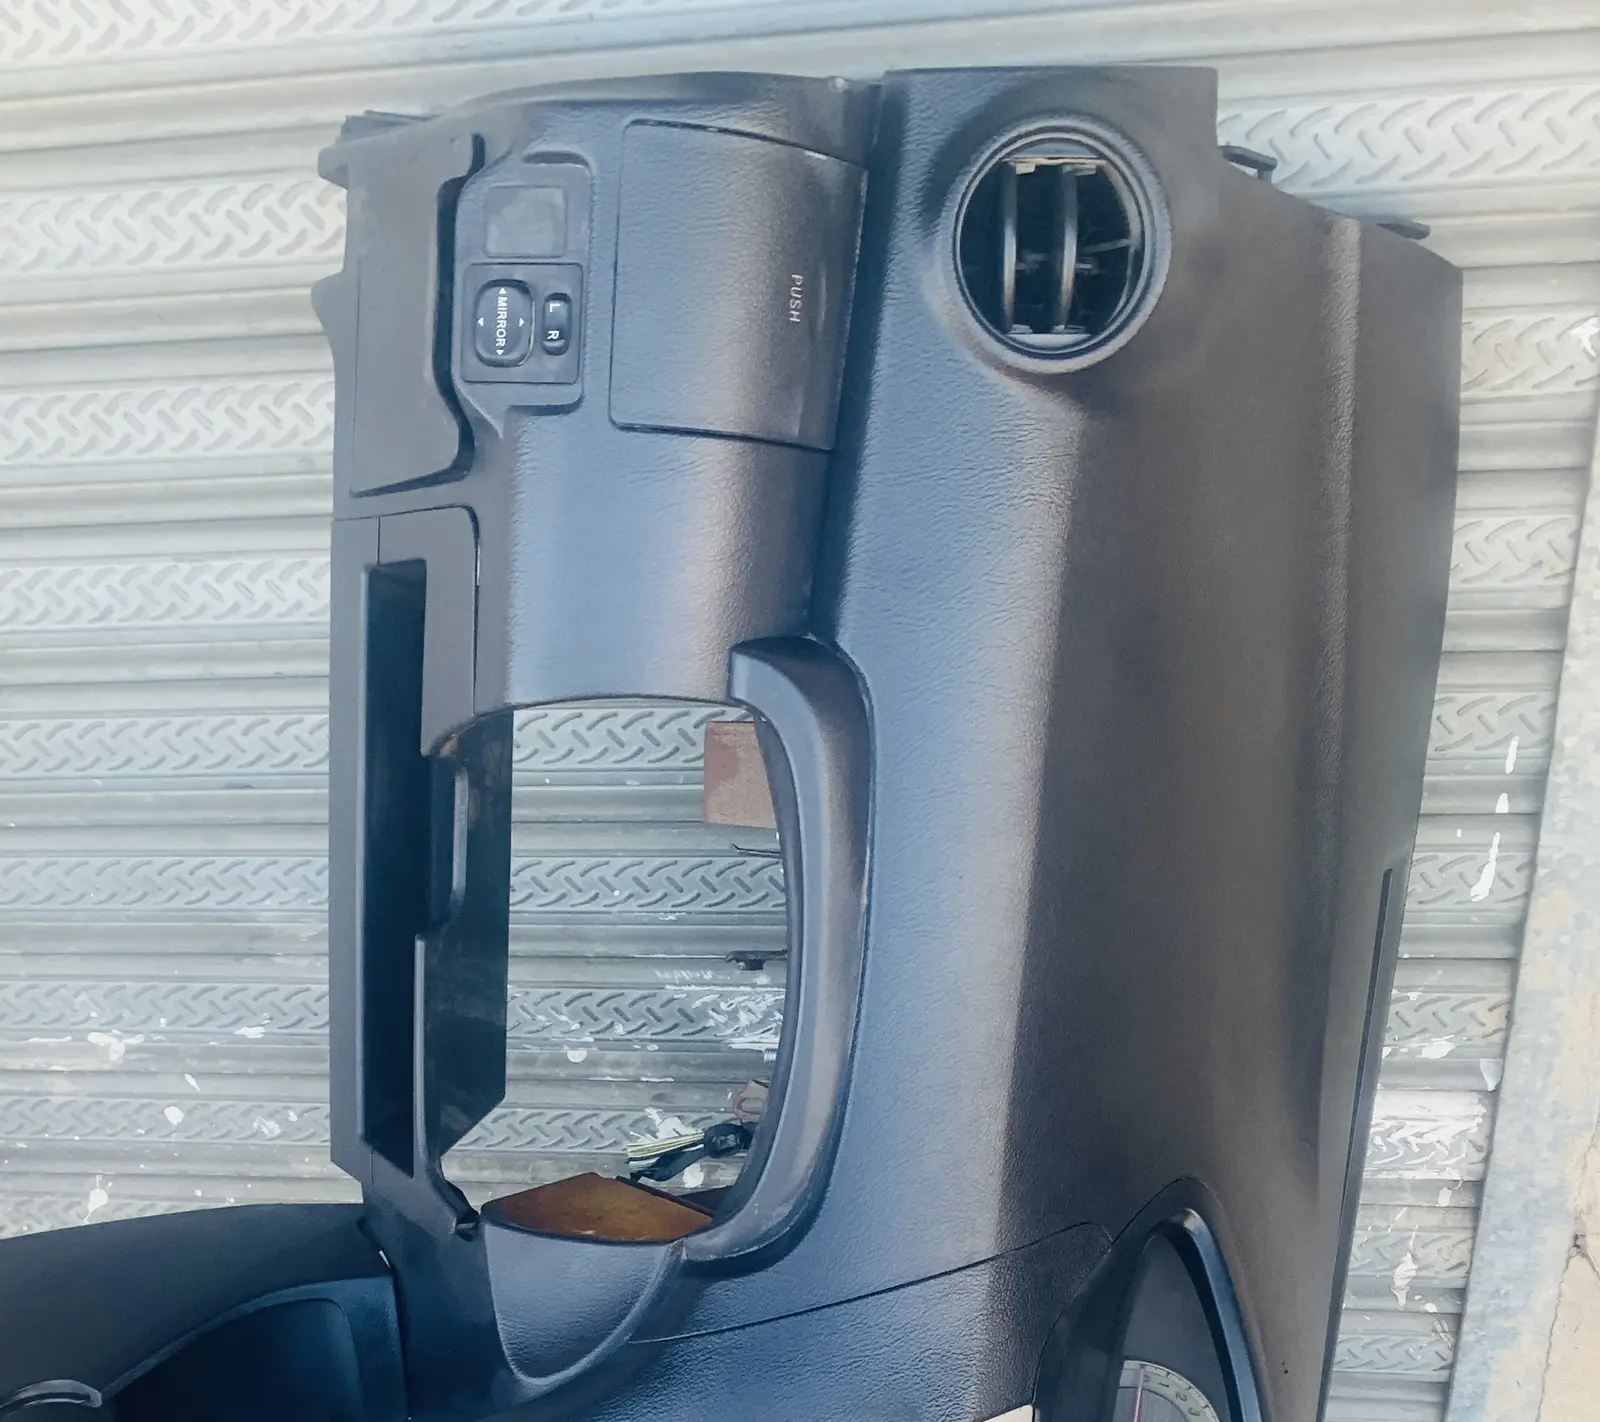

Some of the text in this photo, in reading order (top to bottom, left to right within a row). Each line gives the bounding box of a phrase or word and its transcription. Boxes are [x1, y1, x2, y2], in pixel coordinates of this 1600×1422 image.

[788, 274, 804, 323] PUSH
[496, 296, 508, 347] MIRROR
[547, 303, 561, 340] L R
[1175, 1391, 1187, 1402] 2
[1188, 1407, 1200, 1417] 3
